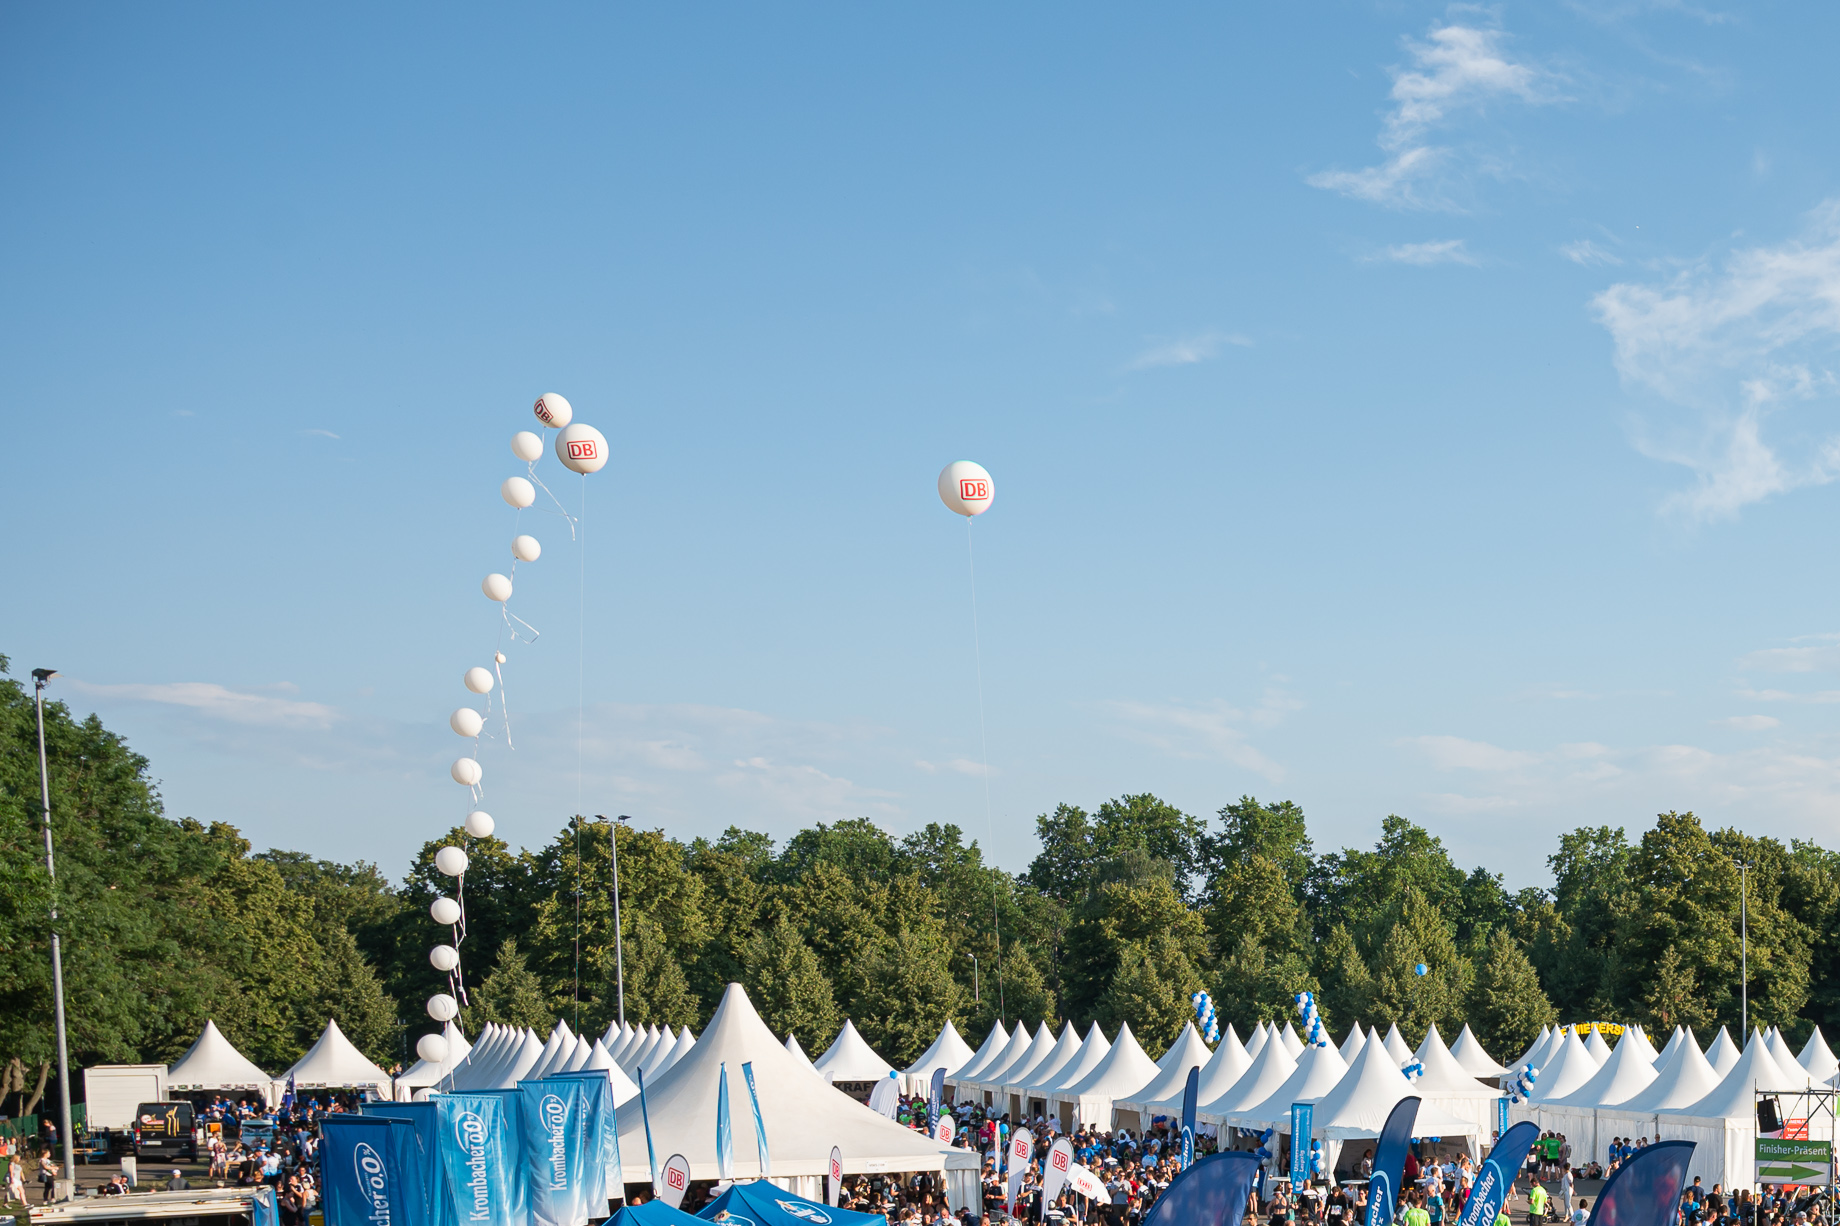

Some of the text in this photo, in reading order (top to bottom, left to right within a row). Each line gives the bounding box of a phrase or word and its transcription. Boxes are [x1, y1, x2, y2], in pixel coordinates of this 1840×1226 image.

[571, 443, 594, 457] DB
[964, 482, 987, 498] DB
[548, 1125, 567, 1191] Krombacher
[1759, 1144, 1827, 1157] Finisher-Präsent
[466, 1147, 490, 1221] Krombacher
